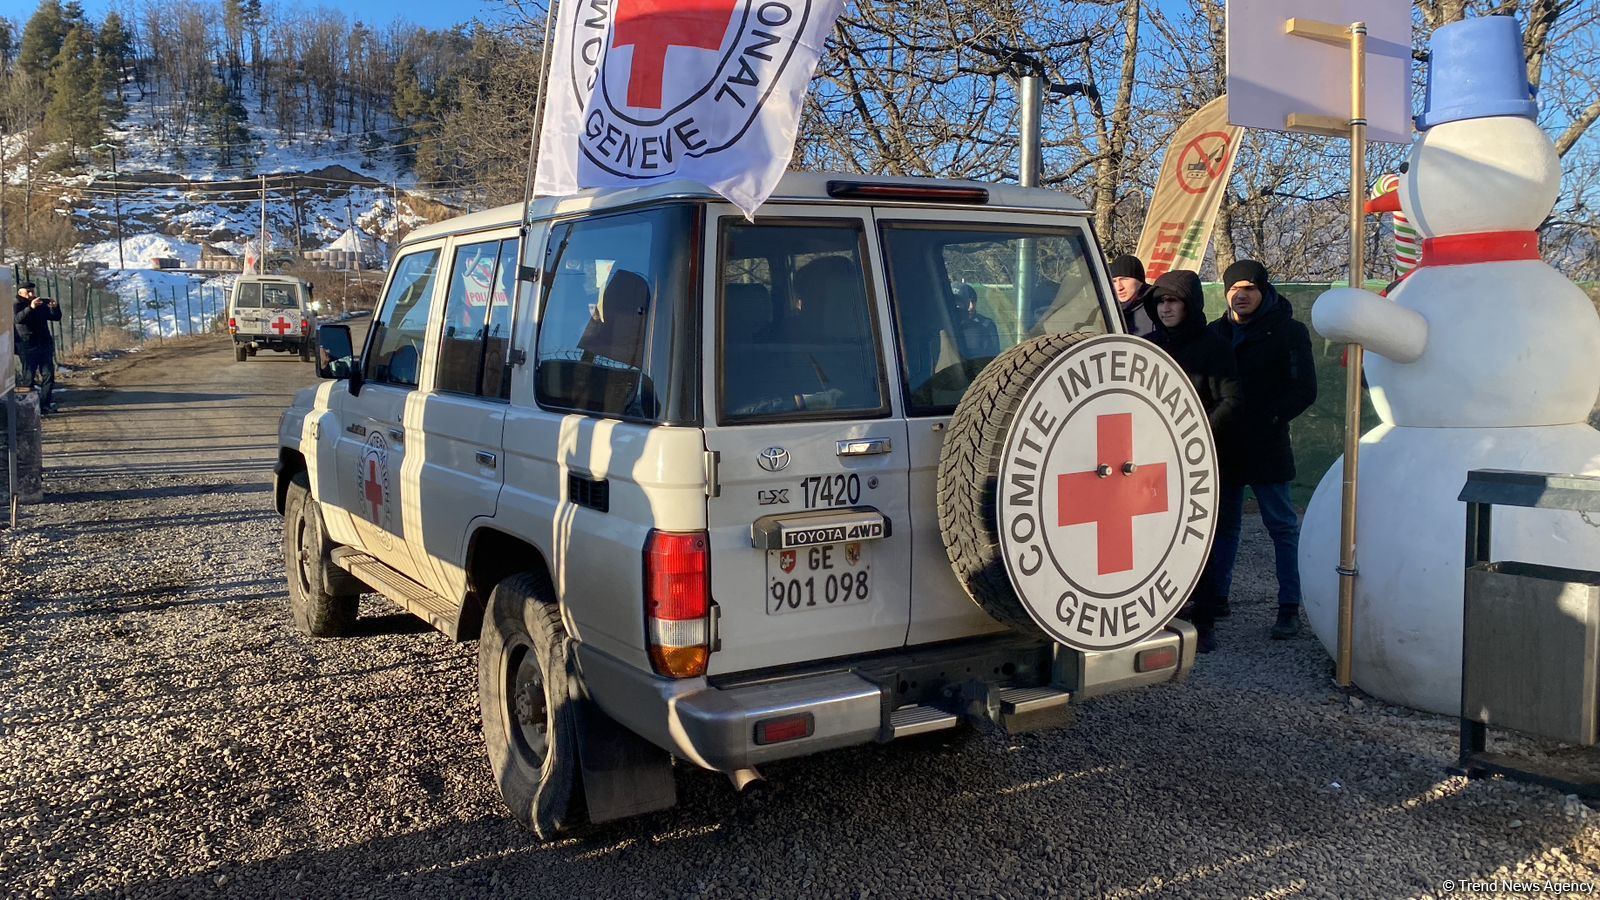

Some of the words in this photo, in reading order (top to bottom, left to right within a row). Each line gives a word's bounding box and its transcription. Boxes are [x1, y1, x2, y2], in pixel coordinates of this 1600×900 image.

[585, 109, 707, 169] GENEVE
[1009, 401, 1057, 577] COMITE
[1057, 350, 1210, 546] INTERNATIONAL
[758, 489, 790, 505] LX
[800, 473, 861, 508] 17420
[788, 528, 844, 544] TOYOTA
[848, 523, 883, 538] 4WD
[808, 545, 834, 570] GE
[772, 577, 817, 611] 901
[825, 570, 869, 604] 098
[1055, 569, 1179, 638] GENEVE
